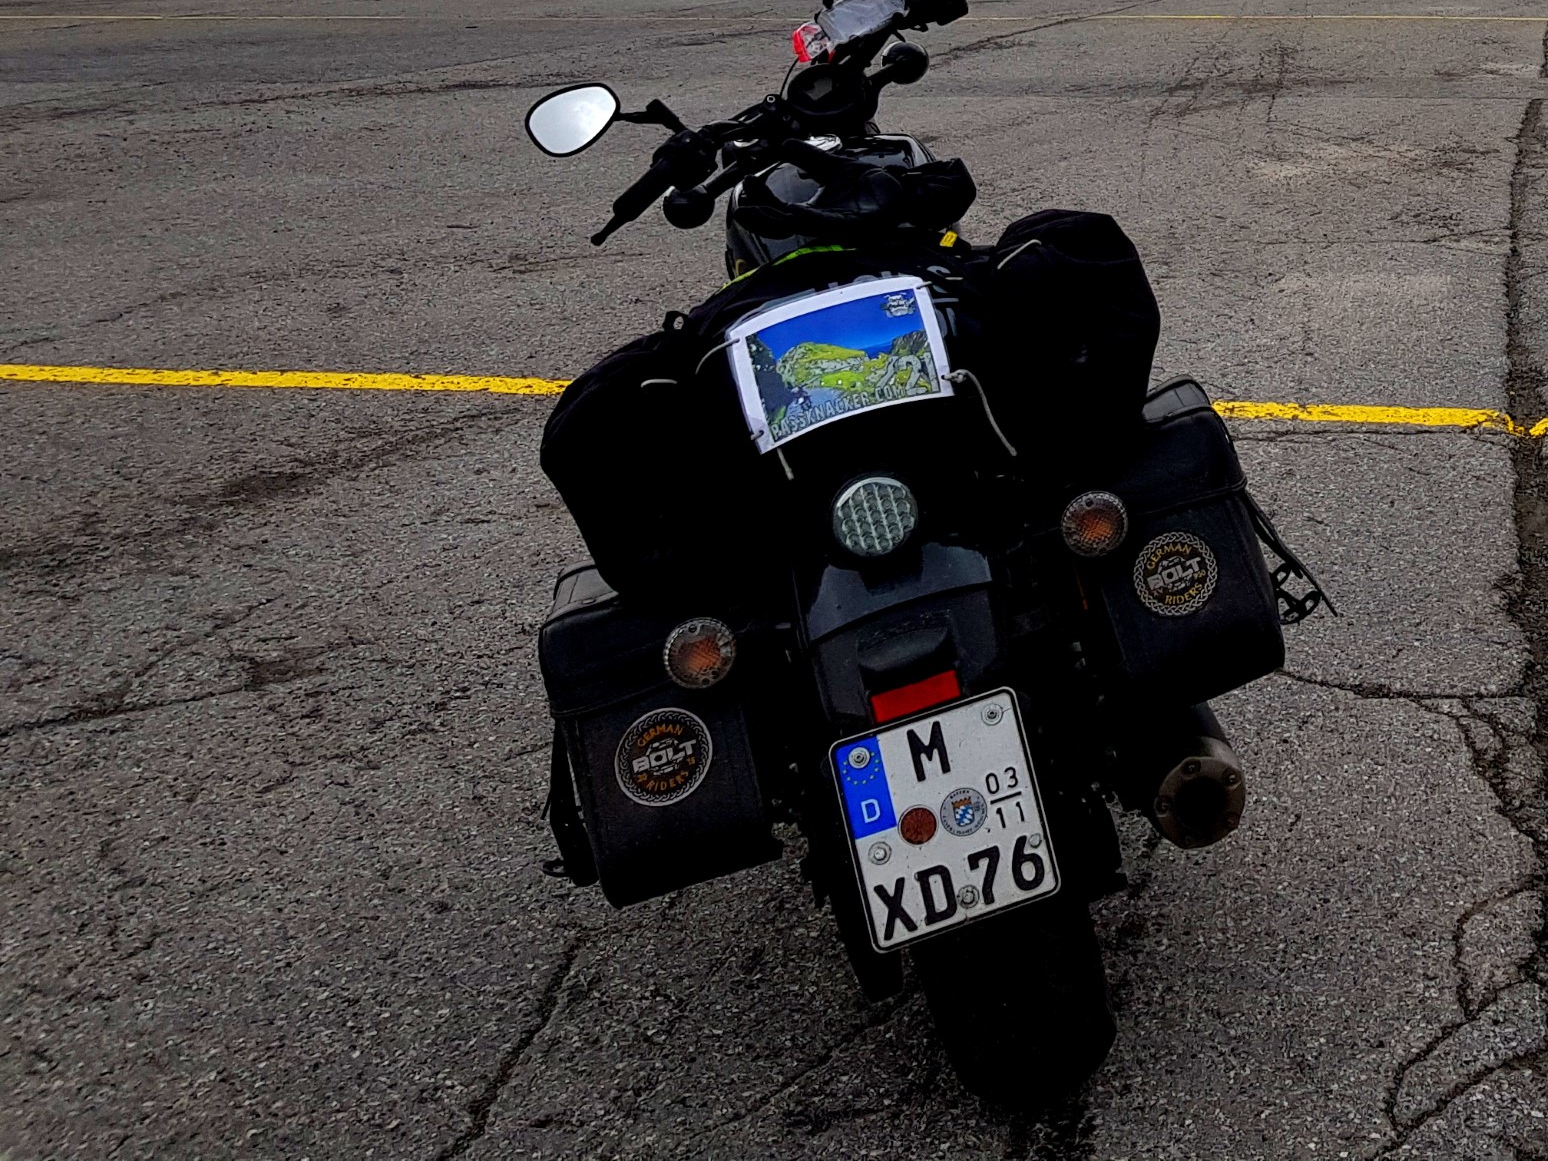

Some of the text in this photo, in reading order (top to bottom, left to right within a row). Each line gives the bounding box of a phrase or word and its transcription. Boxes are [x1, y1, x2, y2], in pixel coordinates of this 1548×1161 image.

[1146, 543, 1192, 570] GERMAN
[1147, 556, 1201, 590] BOLT
[1164, 582, 1203, 605] RIDERS
[637, 723, 685, 747] GERMAN
[632, 738, 697, 773] BOLT
[906, 721, 951, 782] M
[646, 770, 689, 792] RIDERS
[985, 767, 1019, 795] 03
[860, 798, 881, 823] D
[996, 801, 1026, 829] 11
